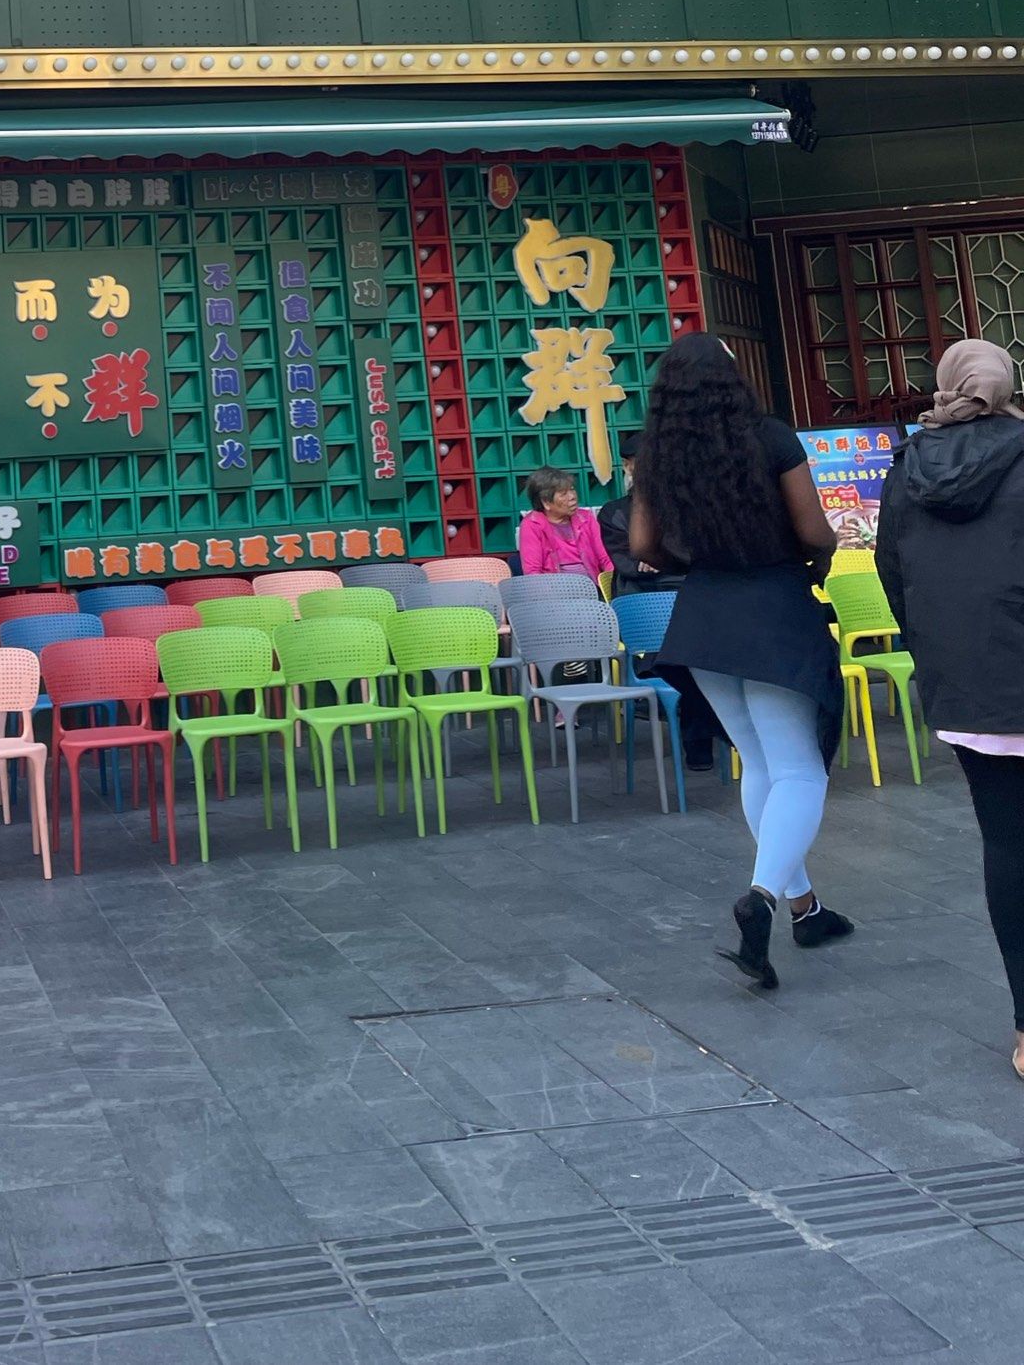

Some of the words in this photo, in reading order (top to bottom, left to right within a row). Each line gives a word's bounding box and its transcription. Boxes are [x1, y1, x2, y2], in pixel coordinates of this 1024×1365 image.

[203, 262, 248, 471] 不闻人间烟火
[278, 260, 323, 465] 但食人间美味
[364, 357, 391, 415] Just
[513, 218, 626, 485] 向群
[816, 433, 891, 453] 向群饭店
[64, 526, 406, 579] 唯有美食与爱不可辜负
